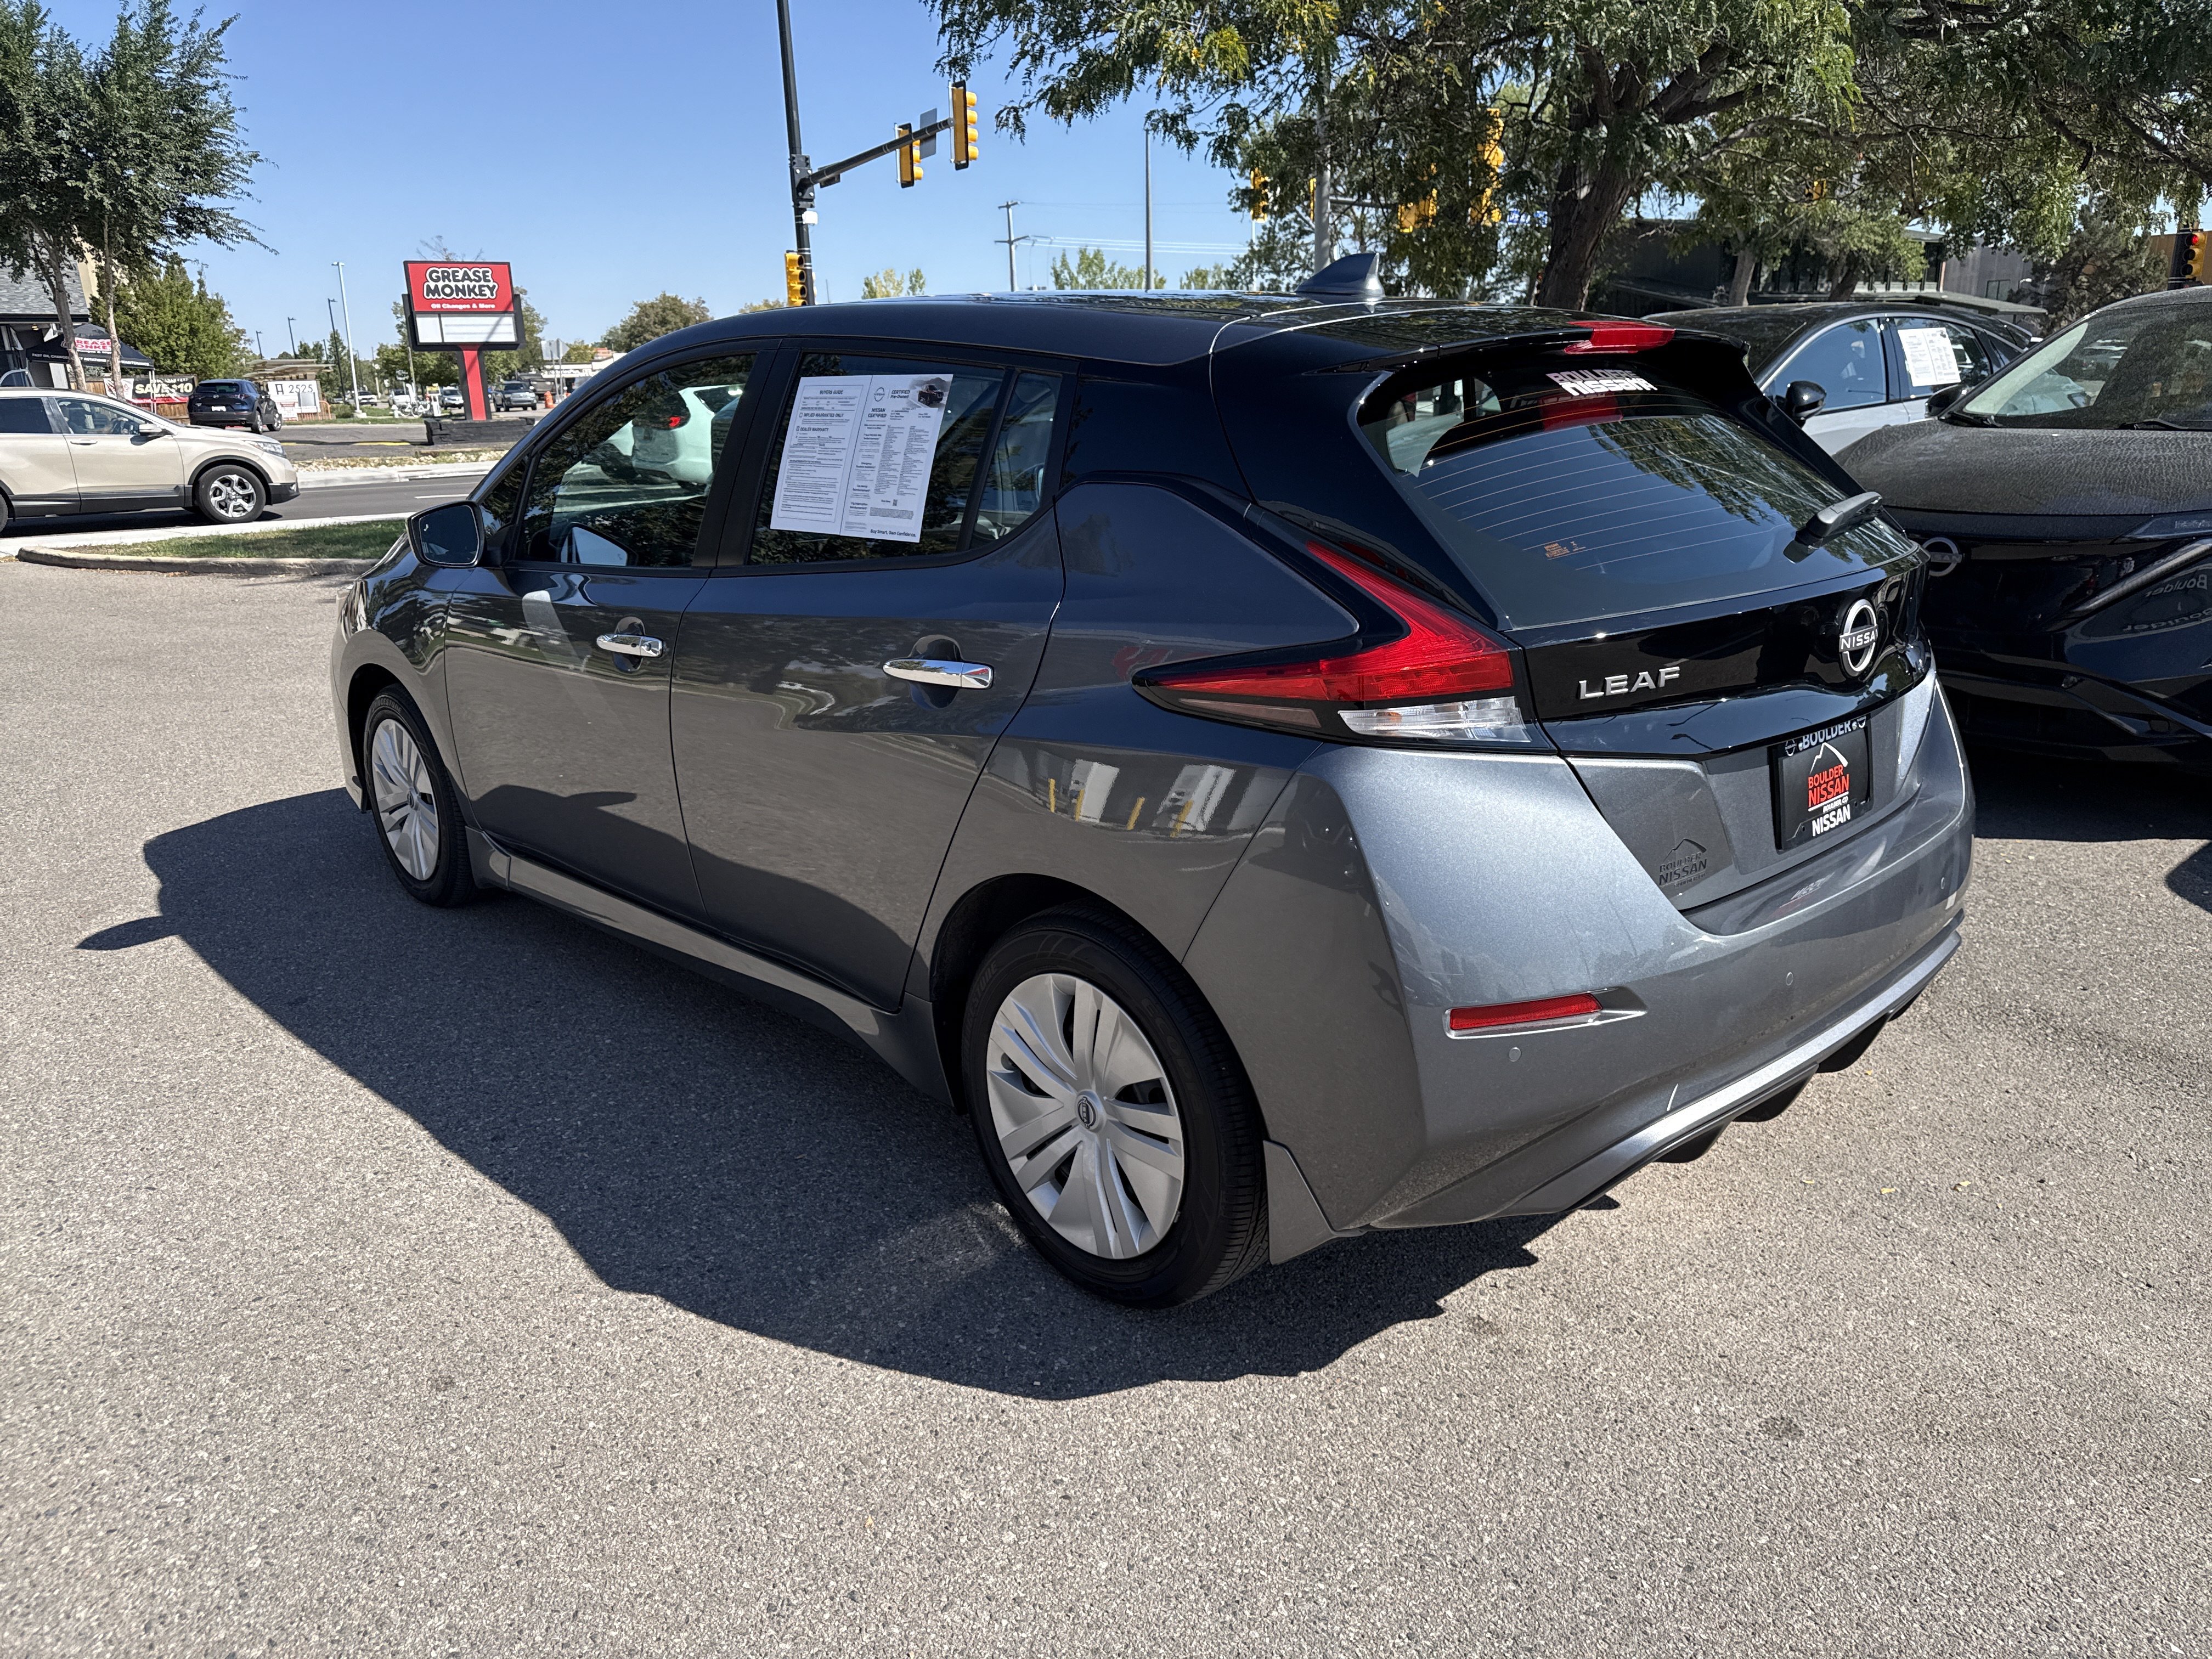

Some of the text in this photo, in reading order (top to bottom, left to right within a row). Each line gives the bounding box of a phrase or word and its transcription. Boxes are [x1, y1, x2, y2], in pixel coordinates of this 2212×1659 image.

[428, 269, 491, 283] GREASE
[426, 284, 496, 297] MONKEY
[135, 383, 170, 393] SAVE
[289, 385, 313, 393] 2525
[1579, 666, 1680, 700] LEAF
[1803, 720, 1852, 750] BOULDER
[1808, 764, 1843, 789] BOULDER
[1808, 774, 1849, 808] NISSAN
[1812, 804, 1850, 837] NISSAN
[1659, 857, 1707, 885] NISSAN
[1660, 851, 1701, 872] BOULDER
